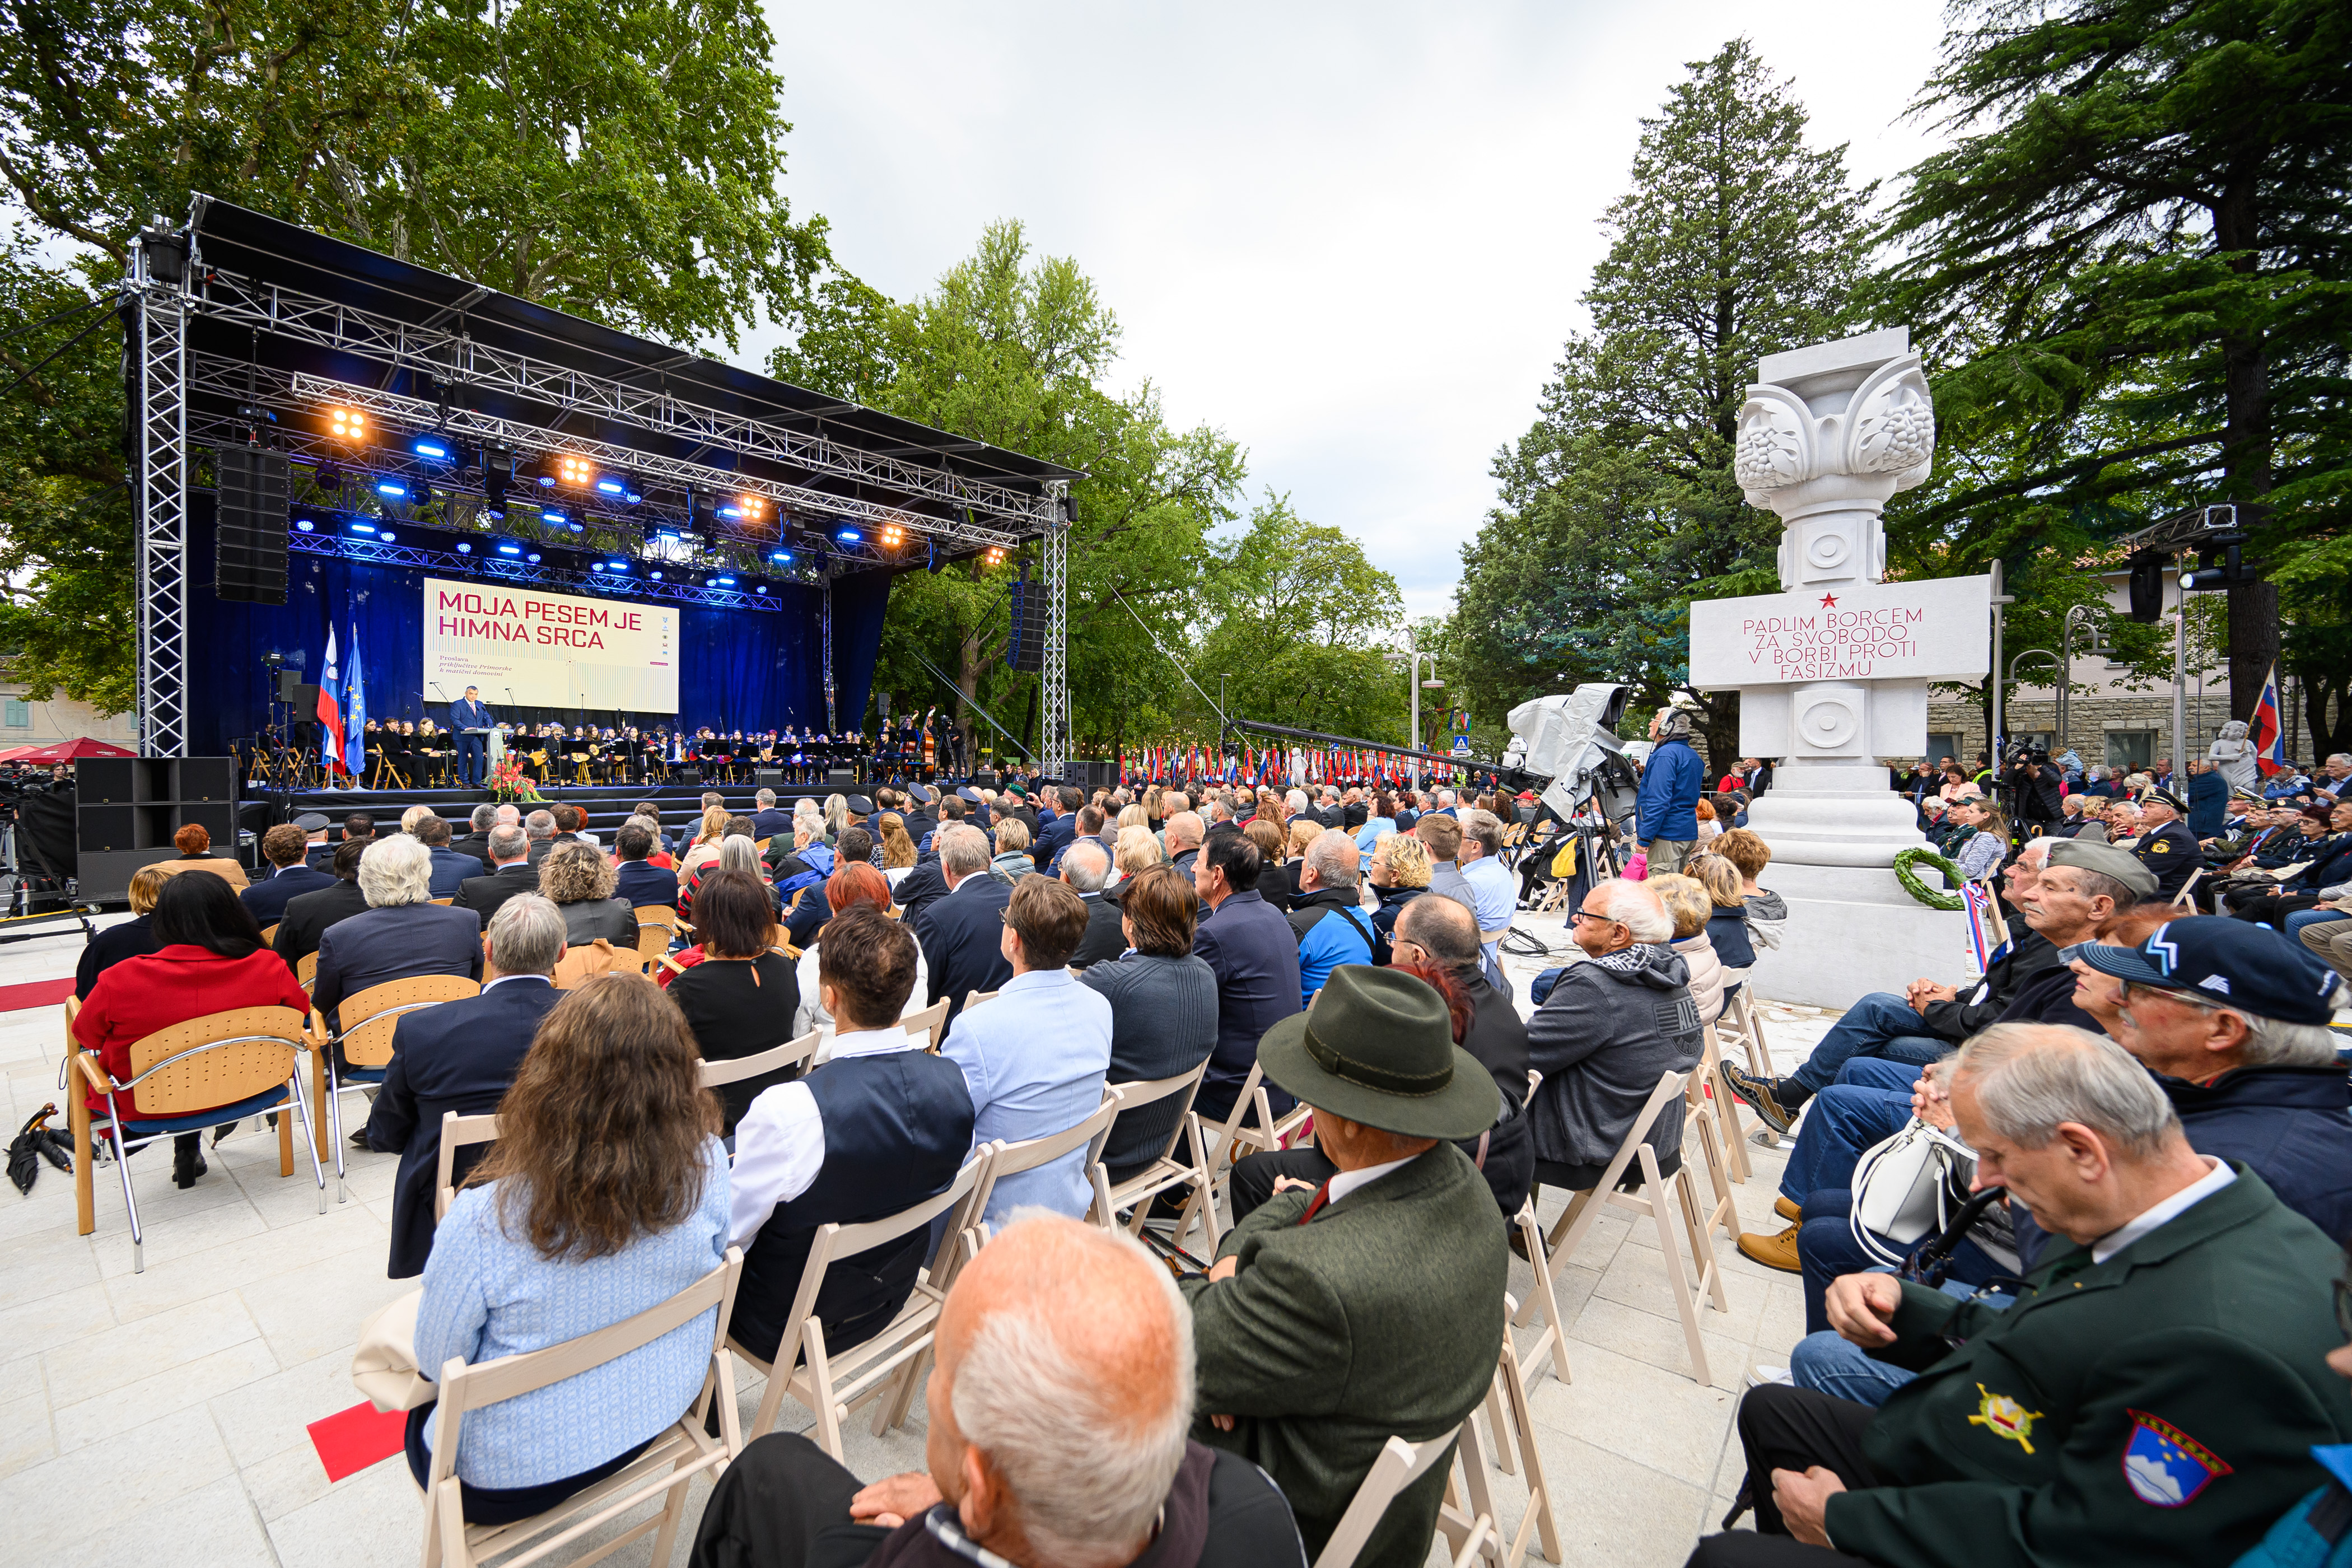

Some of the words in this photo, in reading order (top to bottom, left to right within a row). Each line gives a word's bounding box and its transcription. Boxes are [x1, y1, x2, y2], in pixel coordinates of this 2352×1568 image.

[440, 591, 517, 618] MOJA
[526, 601, 608, 627] PESEM
[614, 612, 641, 631] JE
[1744, 616, 1814, 636] PADLIM
[1827, 608, 1922, 628] BORCEM
[440, 616, 530, 642] HIMNA
[538, 626, 604, 649] SRCA
[1756, 634, 1779, 650] ZA
[1793, 625, 1907, 647] SVOBODO
[1749, 651, 1761, 664] V
[1774, 646, 1836, 665] BORBI
[1850, 641, 1915, 660] PROTI
[1781, 661, 1871, 680] FAŠIZMU
[2135, 1414, 2225, 1473] VETERAN
